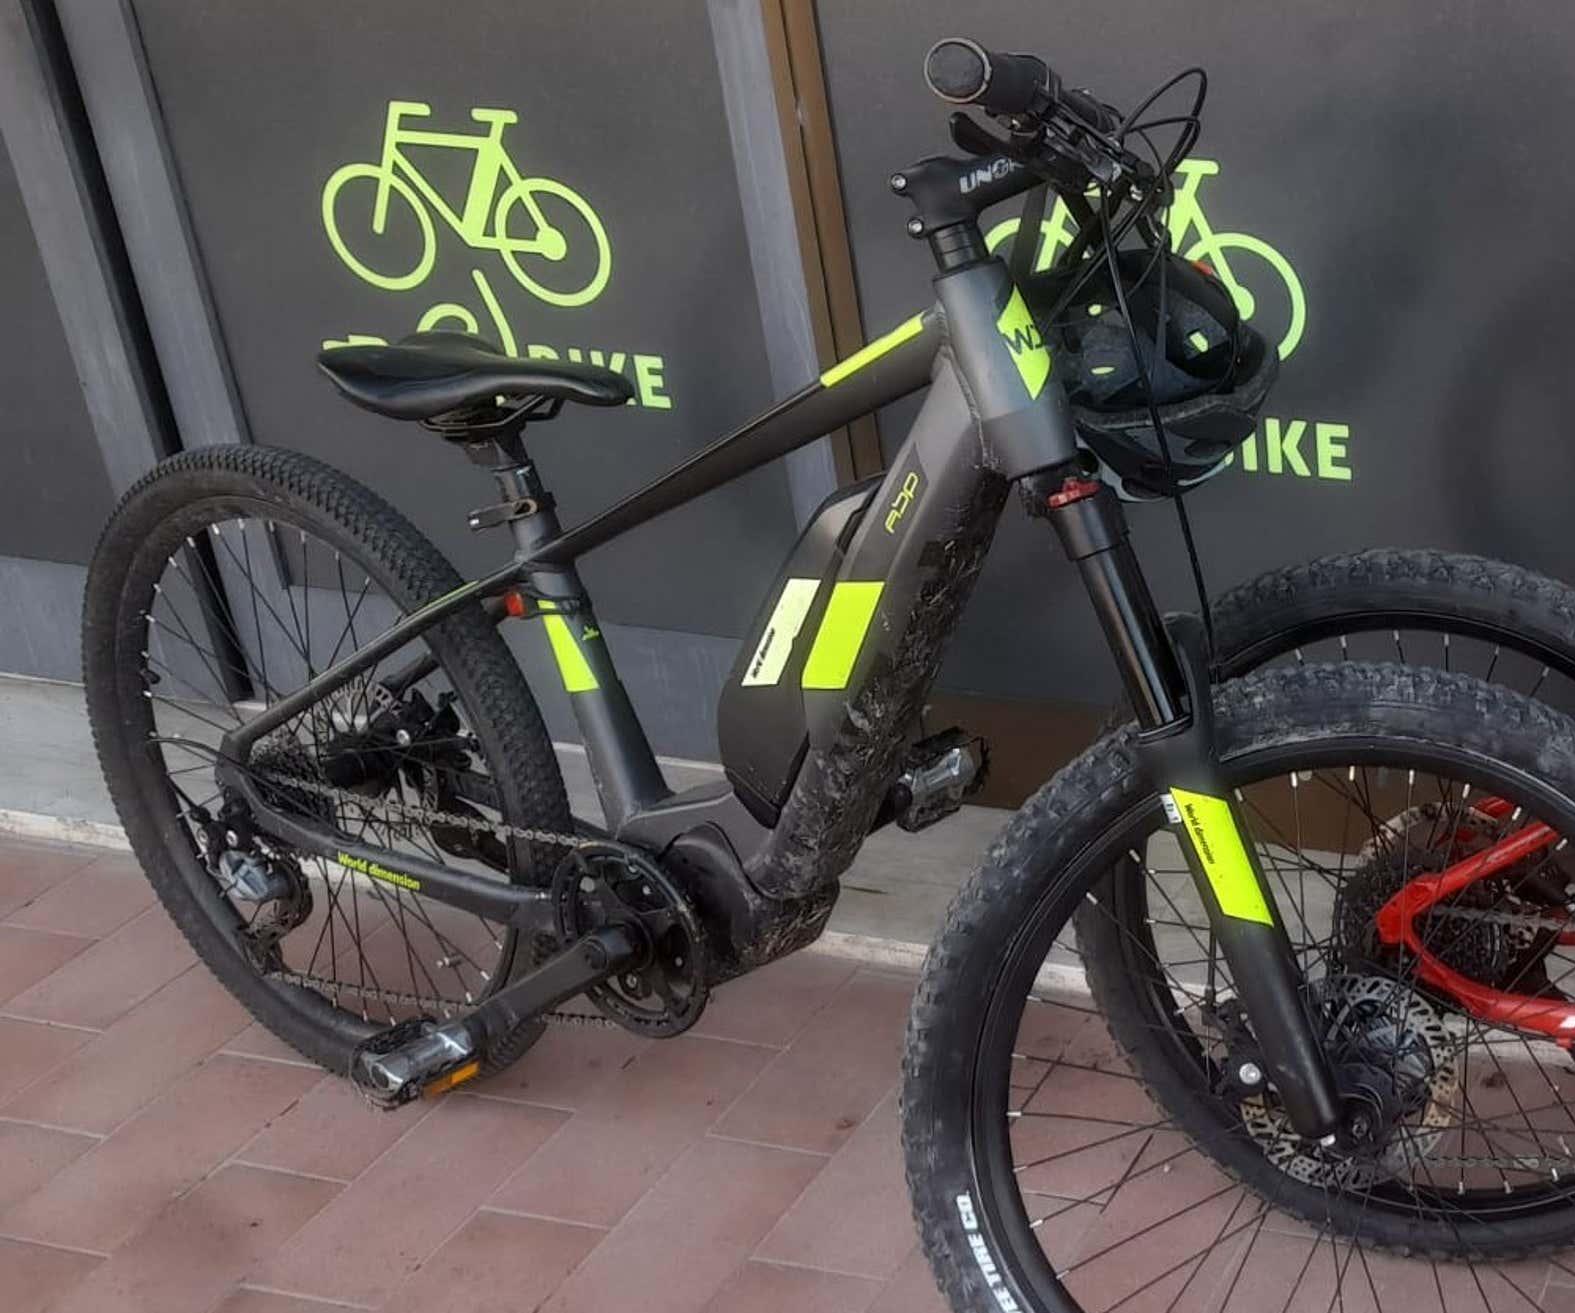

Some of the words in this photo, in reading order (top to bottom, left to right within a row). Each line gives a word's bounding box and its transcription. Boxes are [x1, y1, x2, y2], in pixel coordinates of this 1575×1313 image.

[1224, 417, 1352, 481] IKE
[337, 850, 368, 874] World
[368, 862, 421, 891] dimension
[967, 1232, 1002, 1289] TIRE
